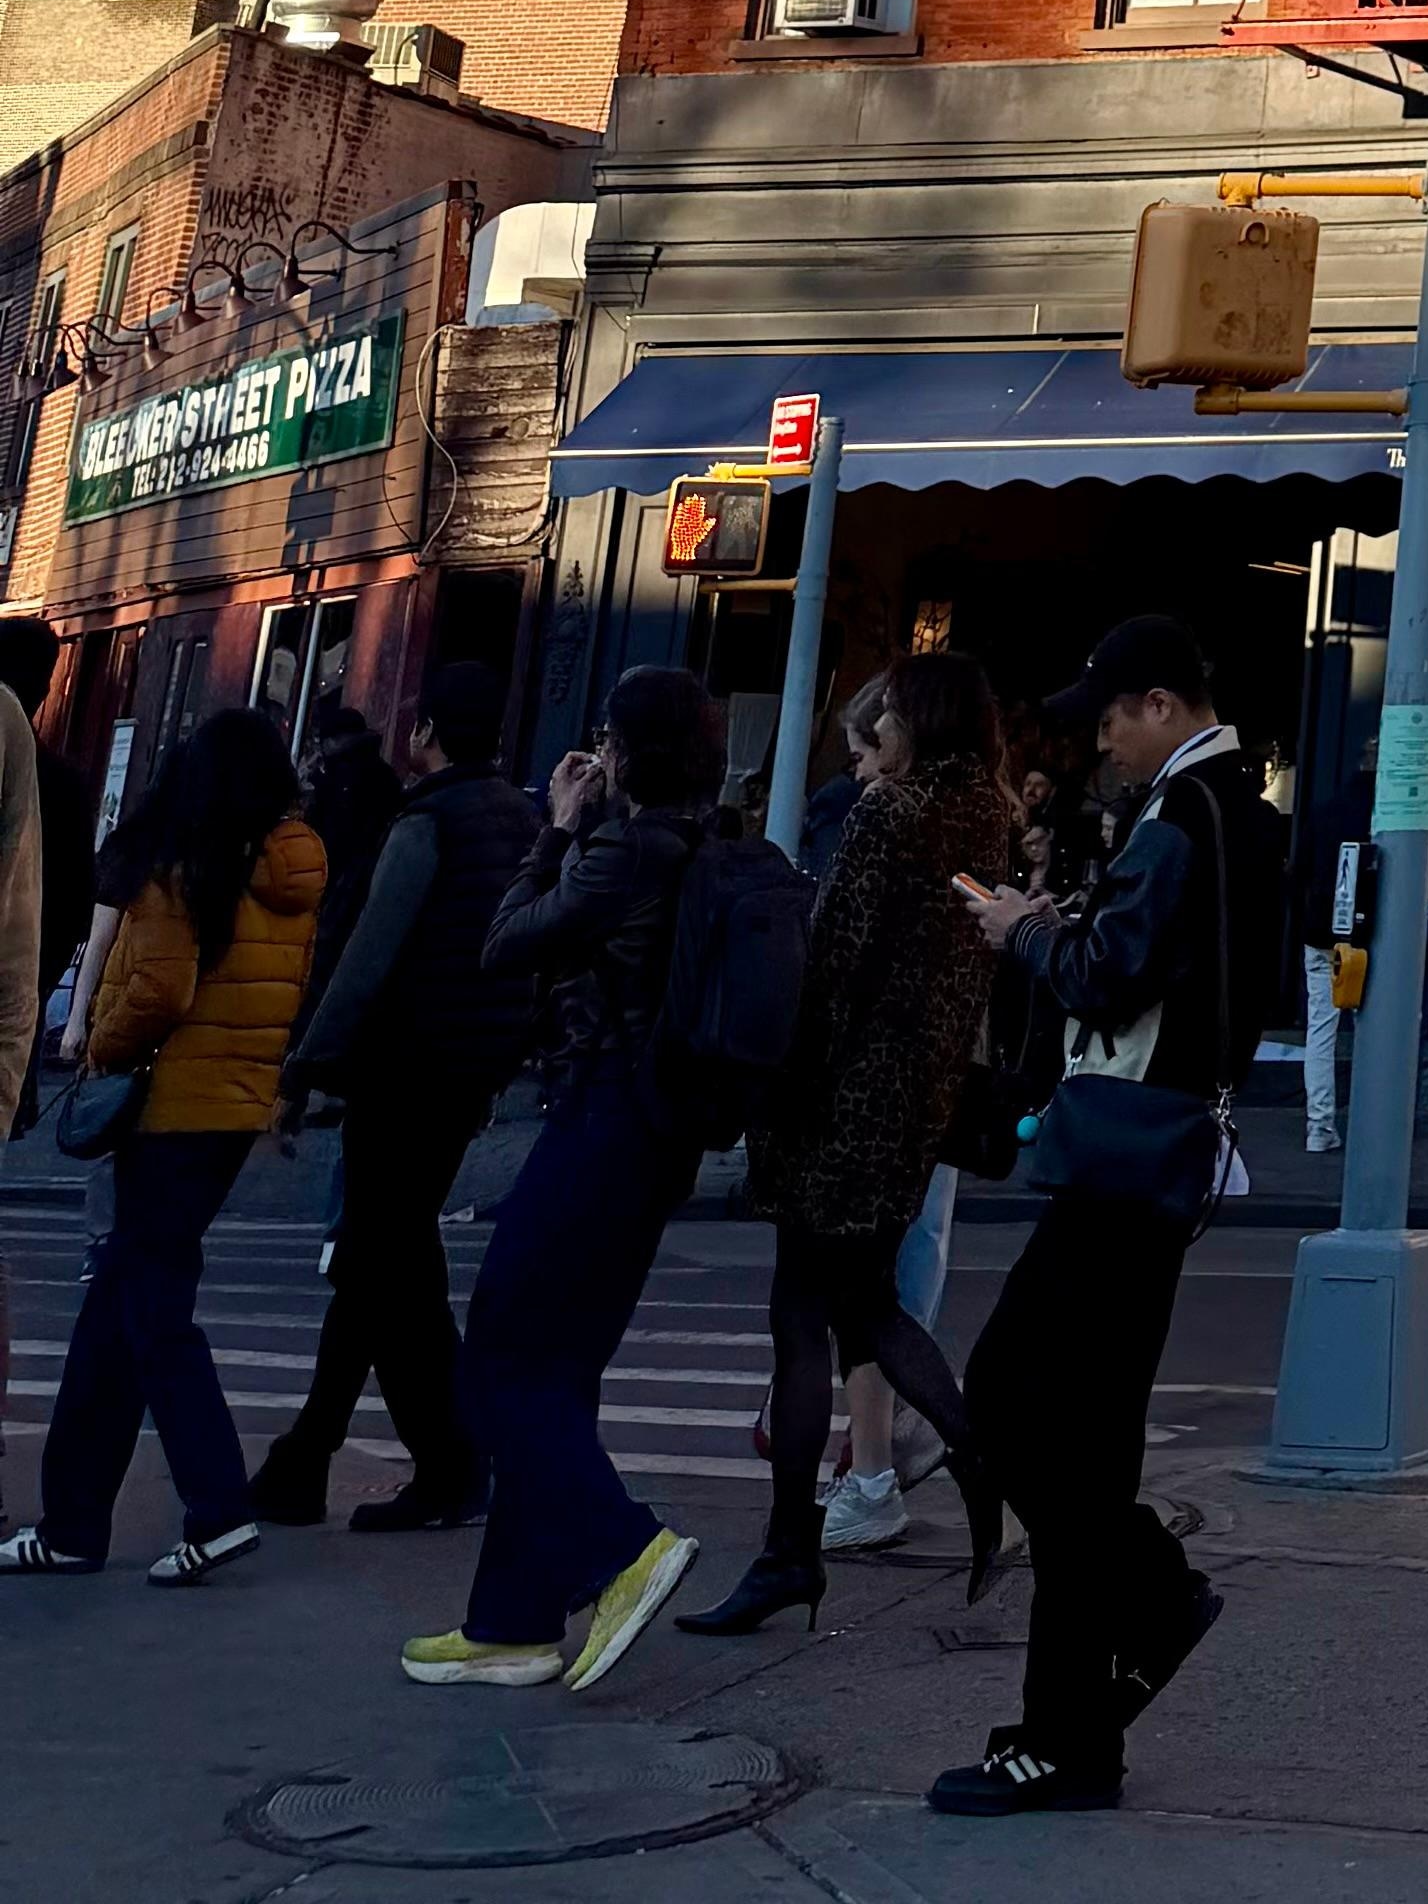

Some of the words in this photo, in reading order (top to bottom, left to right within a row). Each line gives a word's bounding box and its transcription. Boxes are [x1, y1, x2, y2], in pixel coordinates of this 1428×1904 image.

[81, 398, 179, 480] BLEECKER
[180, 364, 281, 448] STREET
[284, 335, 373, 420] PIZZA
[1386, 447, 1407, 469] Th
